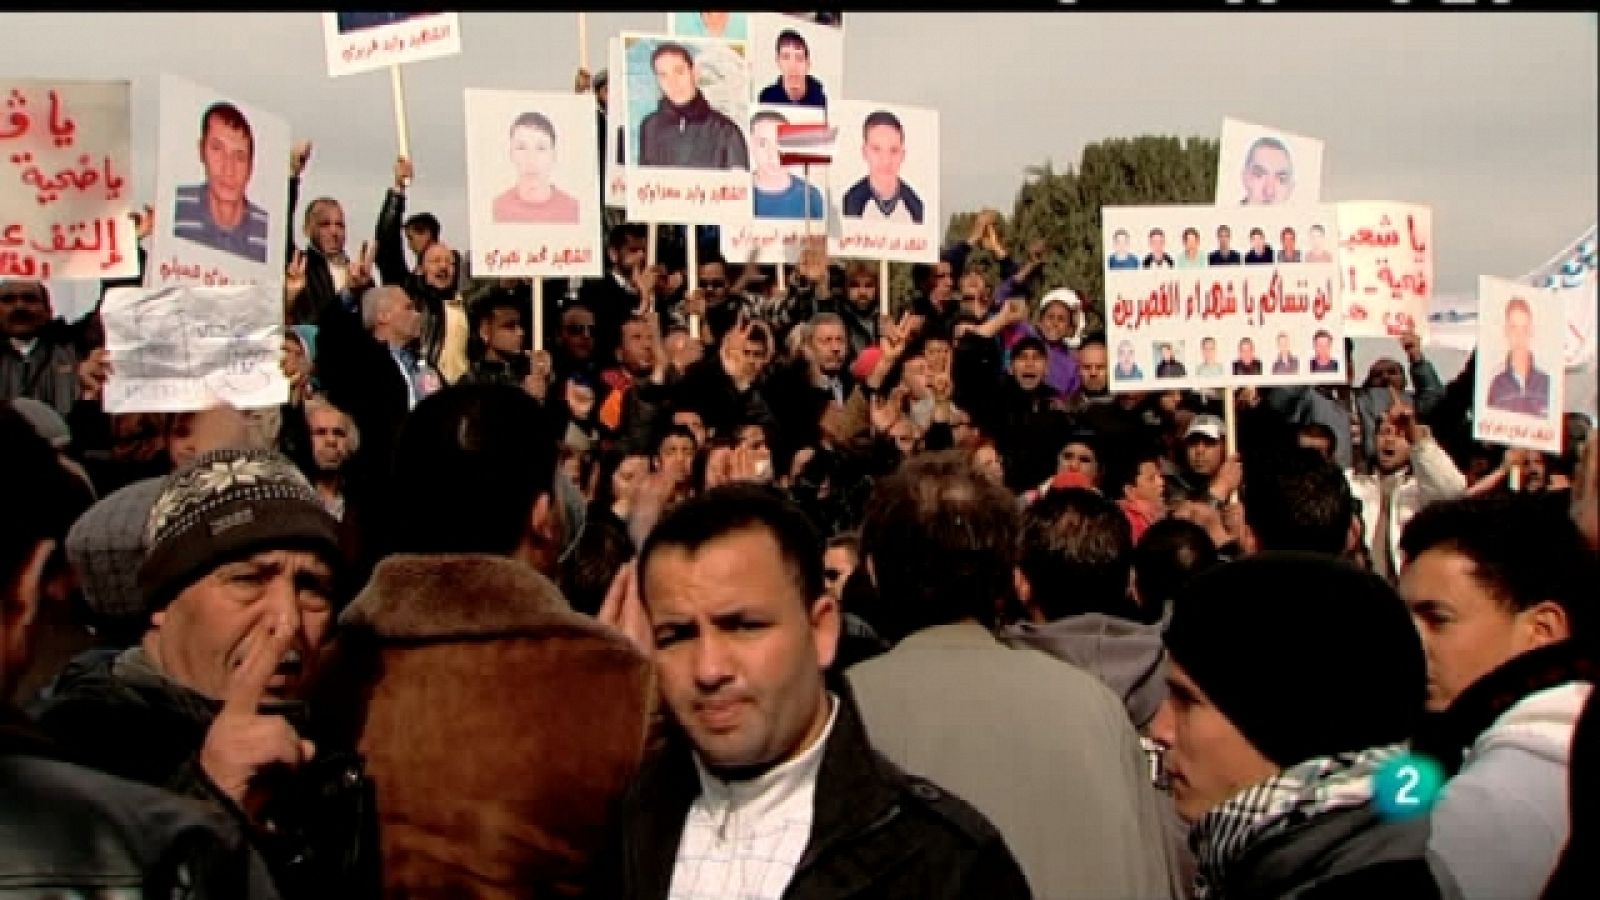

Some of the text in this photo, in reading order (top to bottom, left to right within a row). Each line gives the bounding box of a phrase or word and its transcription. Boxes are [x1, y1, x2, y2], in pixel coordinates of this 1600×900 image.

[49, 90, 75, 147] يا
[551, 248, 593, 270] الشهيد
[1407, 213, 1427, 264] يا
[1185, 278, 1238, 320] شهداء
[1243, 277, 1256, 326] يا
[1312, 278, 1333, 320] لن
